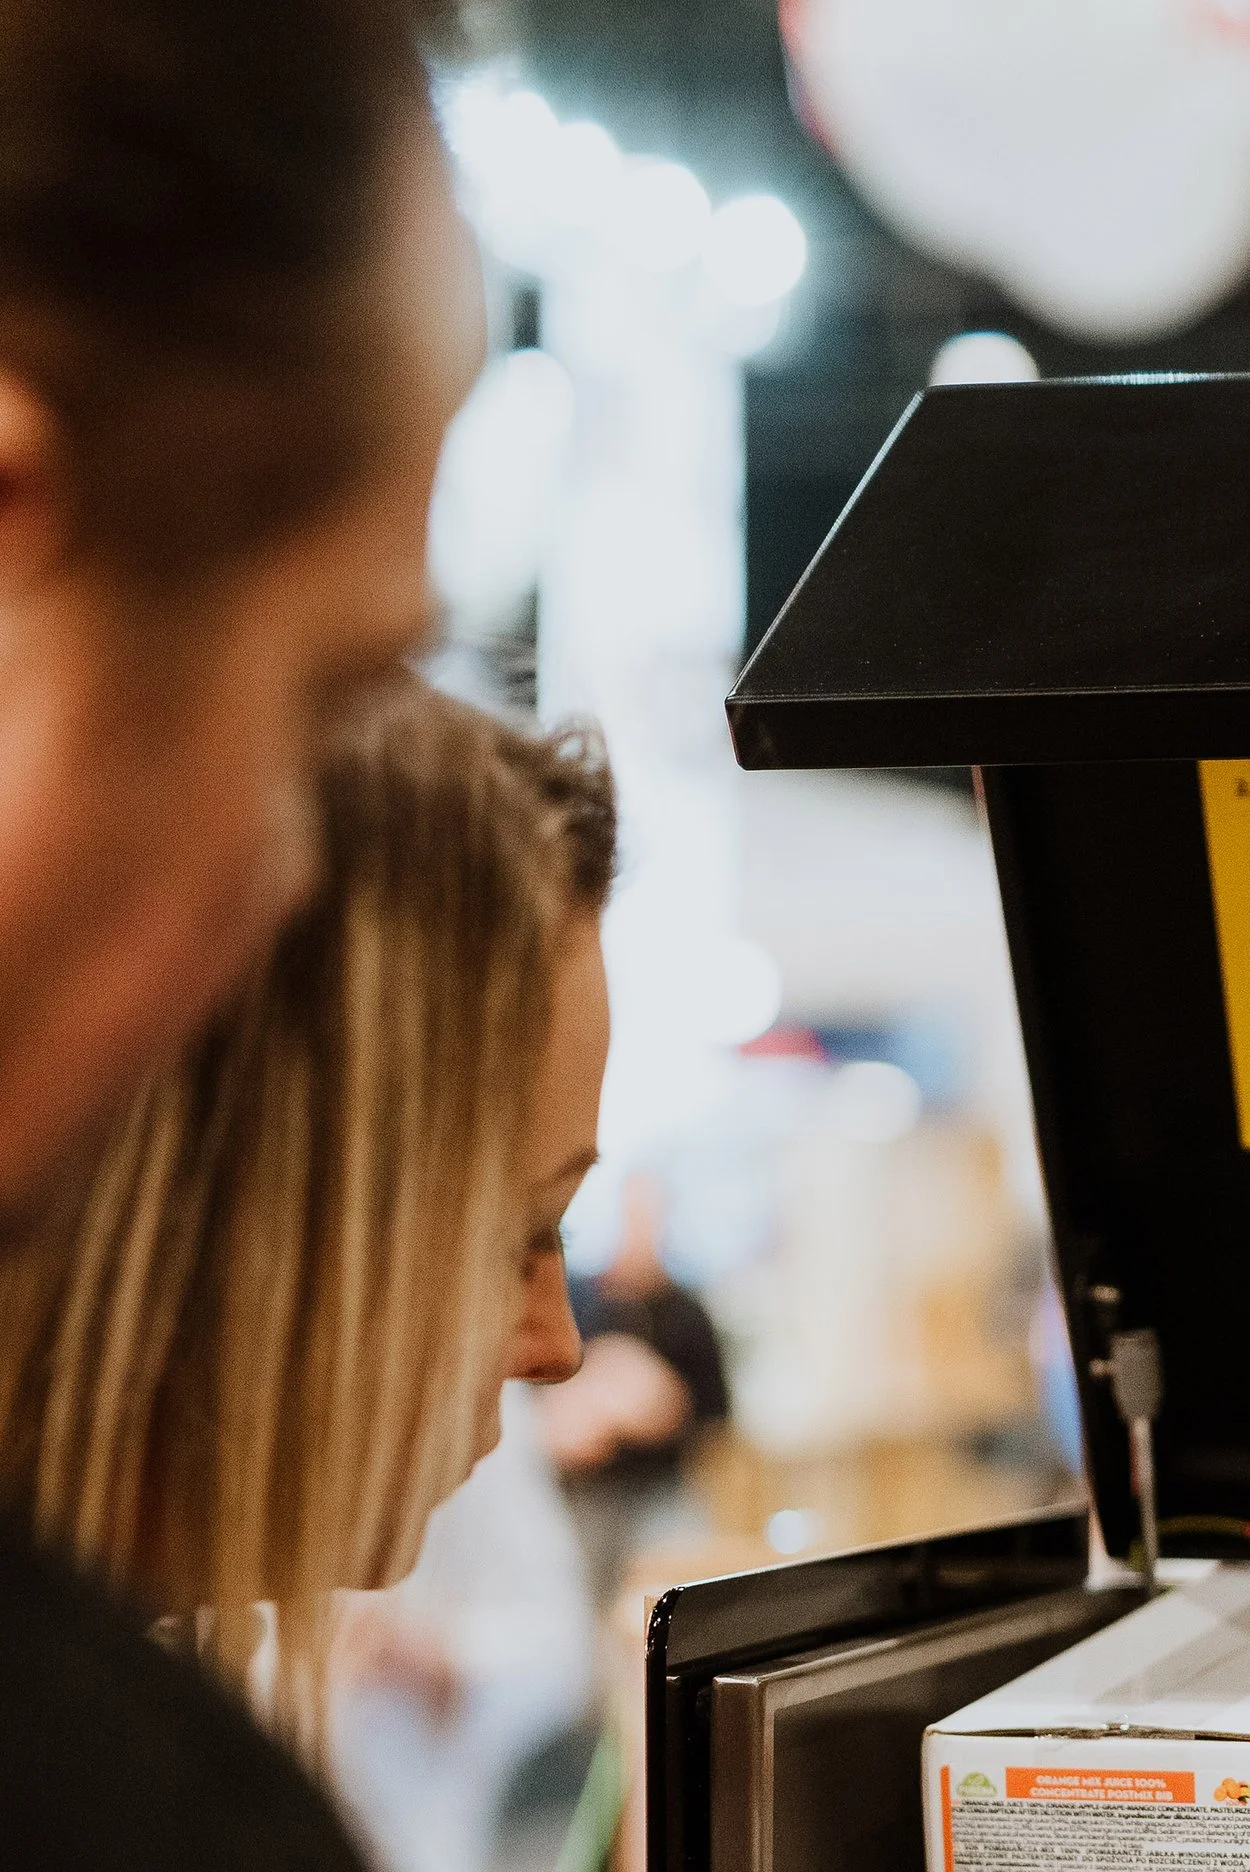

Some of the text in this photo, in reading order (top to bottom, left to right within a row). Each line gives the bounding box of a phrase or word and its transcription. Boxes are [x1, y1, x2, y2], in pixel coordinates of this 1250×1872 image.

[1036, 1775, 1166, 1789] ORANGE MIX JUICE 100%
[1031, 1787, 1173, 1800] CONCENTRATE POSTMIX BIB
